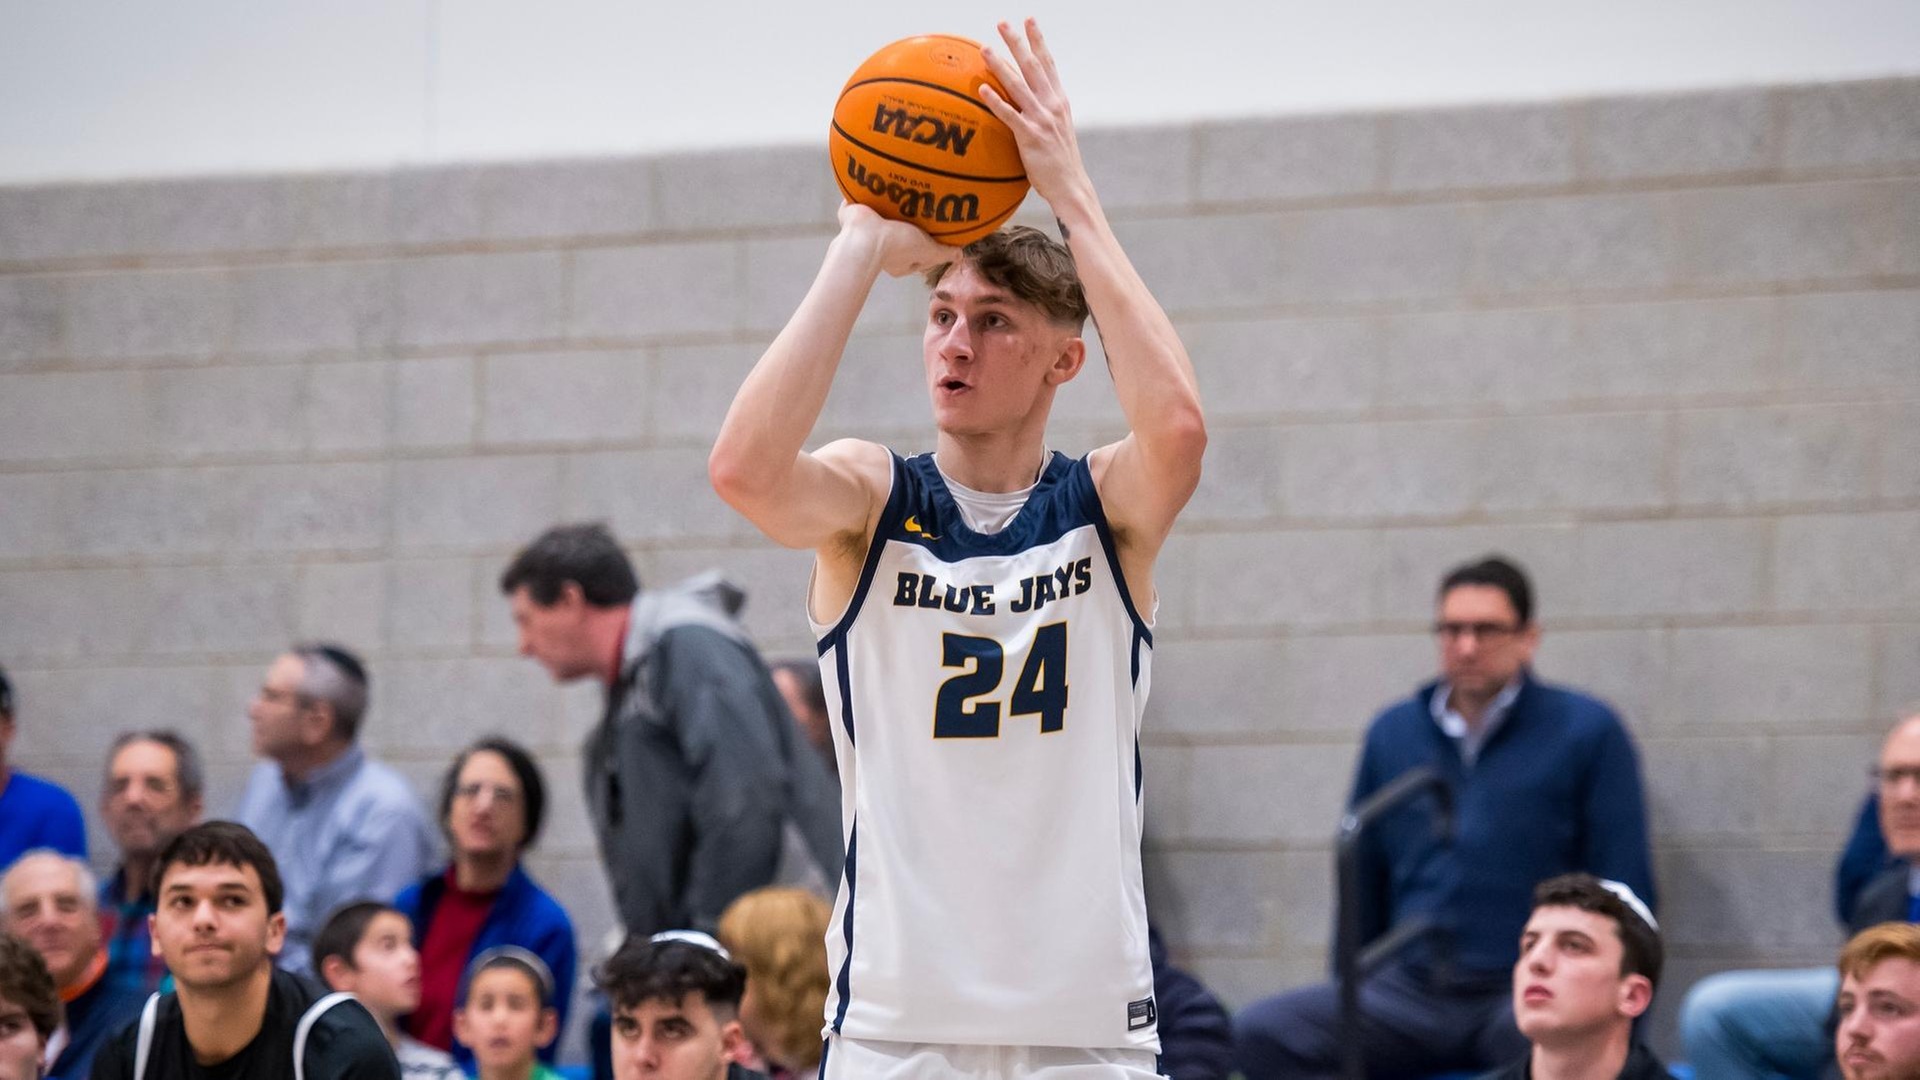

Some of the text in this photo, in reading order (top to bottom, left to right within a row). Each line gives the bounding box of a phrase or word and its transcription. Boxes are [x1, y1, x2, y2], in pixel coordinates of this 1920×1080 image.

[872, 103, 977, 157] NCAA
[846, 157, 980, 223] Wilson
[888, 171, 908, 183] NXT
[893, 556, 1092, 615] BLUE JAYS
[933, 620, 1069, 739] 24
